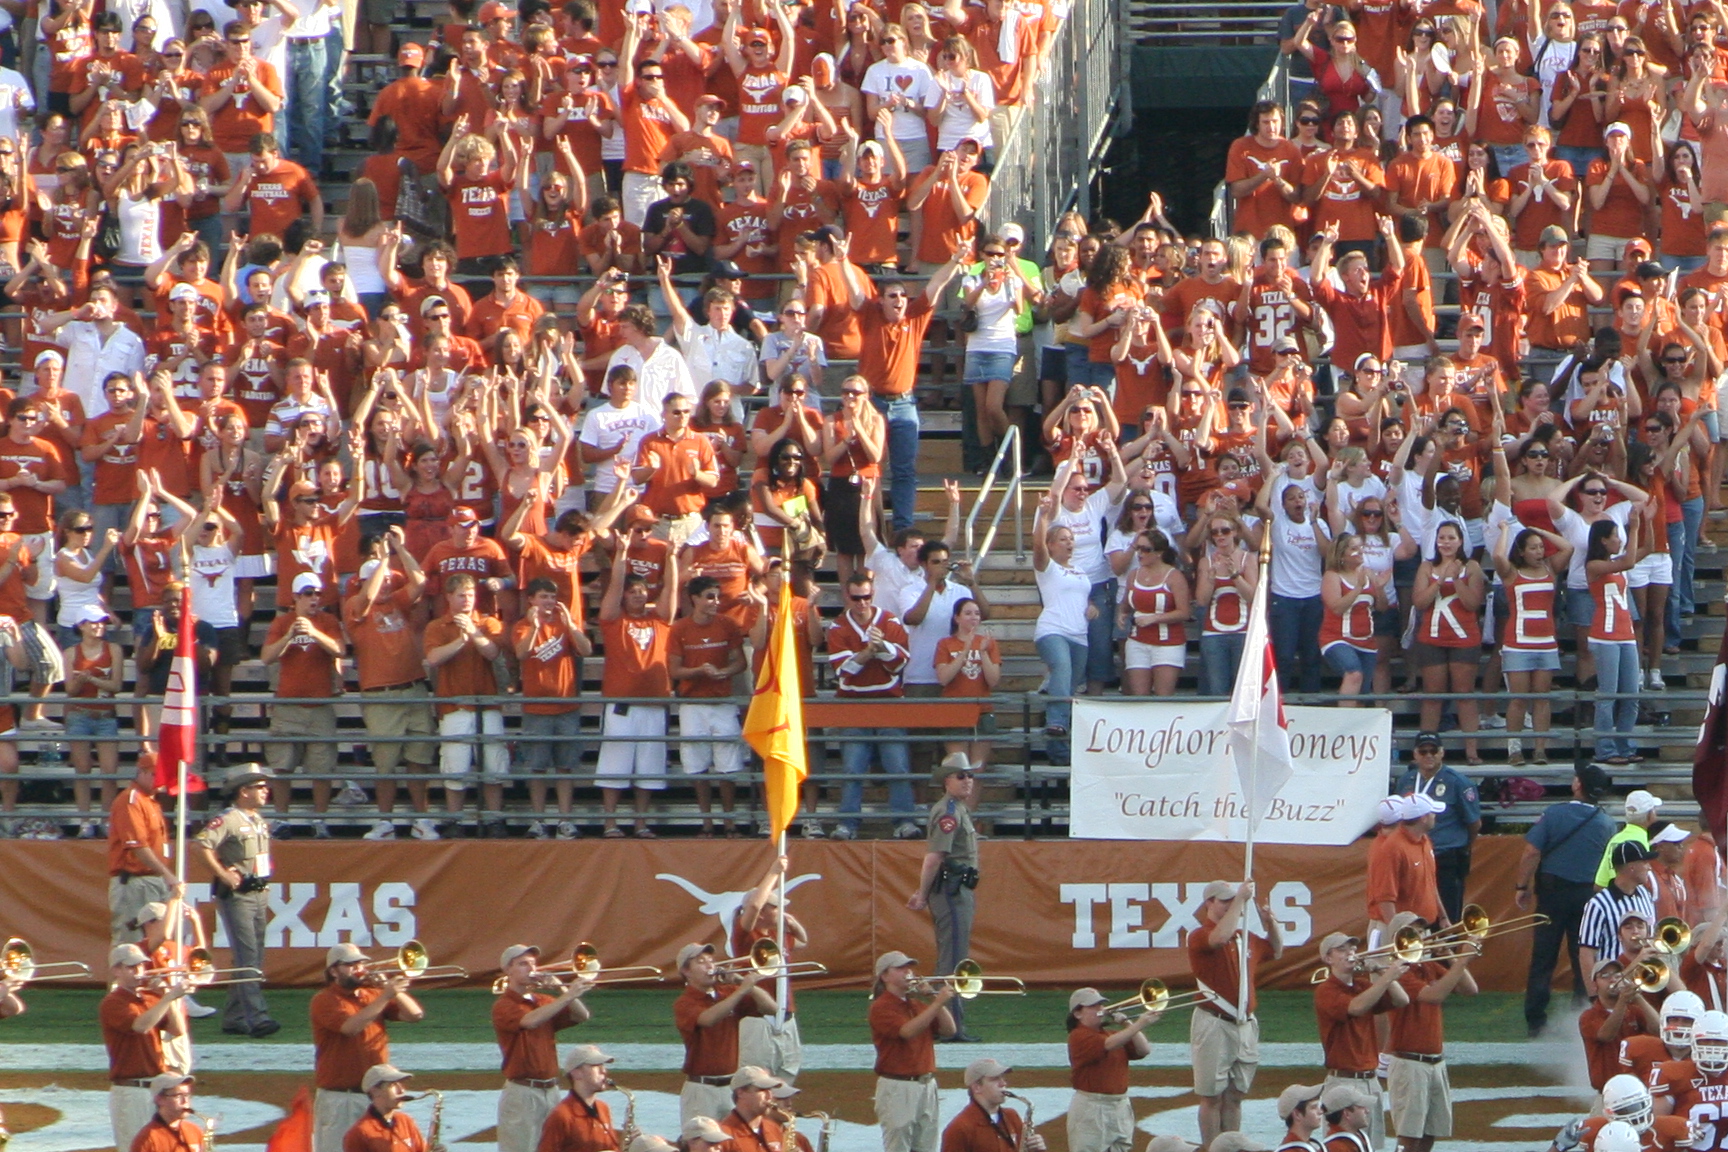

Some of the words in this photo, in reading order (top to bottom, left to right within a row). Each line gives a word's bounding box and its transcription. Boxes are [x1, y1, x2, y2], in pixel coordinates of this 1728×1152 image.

[461, 187, 498, 203] TEXAS
[857, 186, 889, 200] TEXAS
[727, 215, 769, 231] TEXAS
[1259, 305, 1298, 347] 32
[605, 418, 647, 434] TEXAS
[438, 556, 488, 574] TEXAS
[1208, 586, 1248, 632] O
[1429, 596, 1469, 639] K
[1514, 582, 1556, 644] E
[1284, 712, 1380, 776] oneys
[1114, 791, 1201, 819] "Catch
[1213, 794, 1249, 819] the
